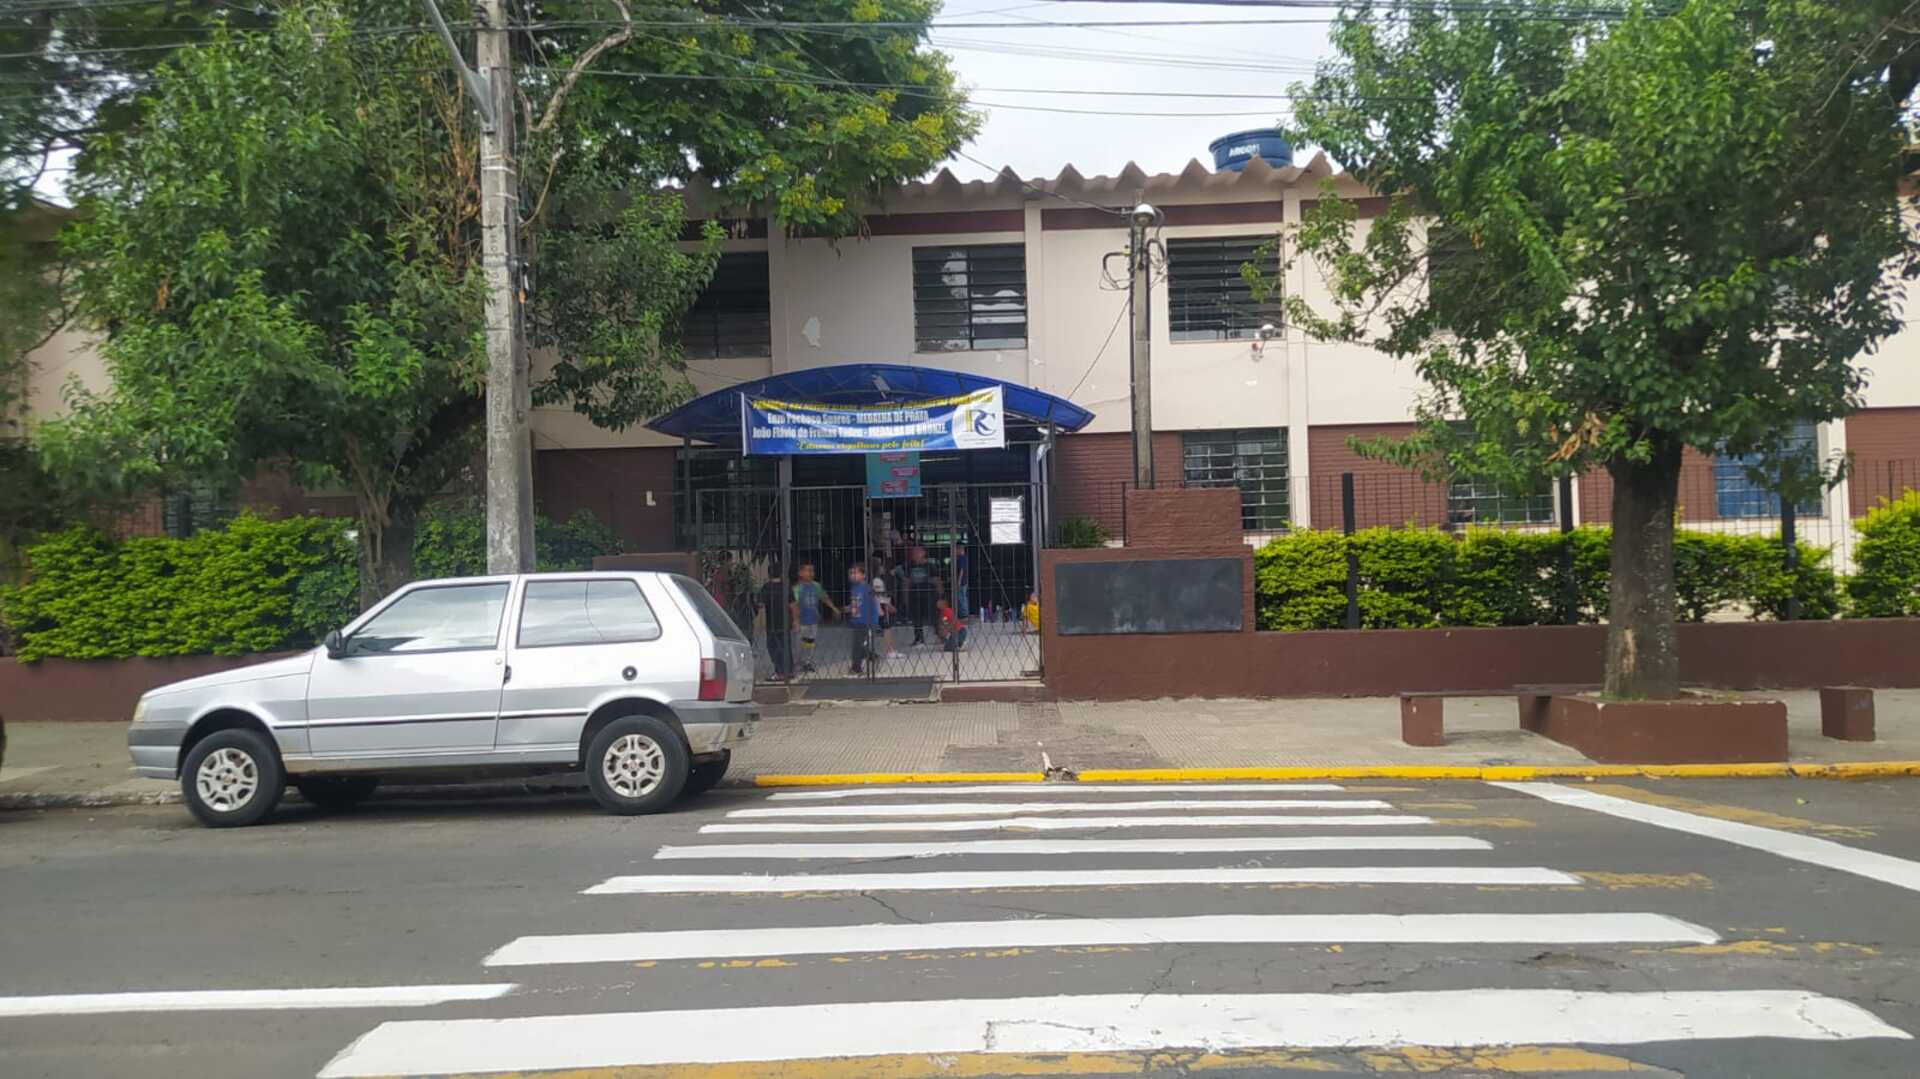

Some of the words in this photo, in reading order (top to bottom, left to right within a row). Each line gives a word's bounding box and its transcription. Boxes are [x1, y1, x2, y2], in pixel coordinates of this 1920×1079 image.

[823, 413, 850, 425] Soares
[857, 411, 893, 424] MEDALHA
[895, 410, 904, 422] DE
[905, 409, 928, 422] PRATA
[753, 426, 771, 438] João
[798, 427, 808, 438] de
[869, 426, 904, 438] MEDALHA
[905, 425, 914, 435] DE
